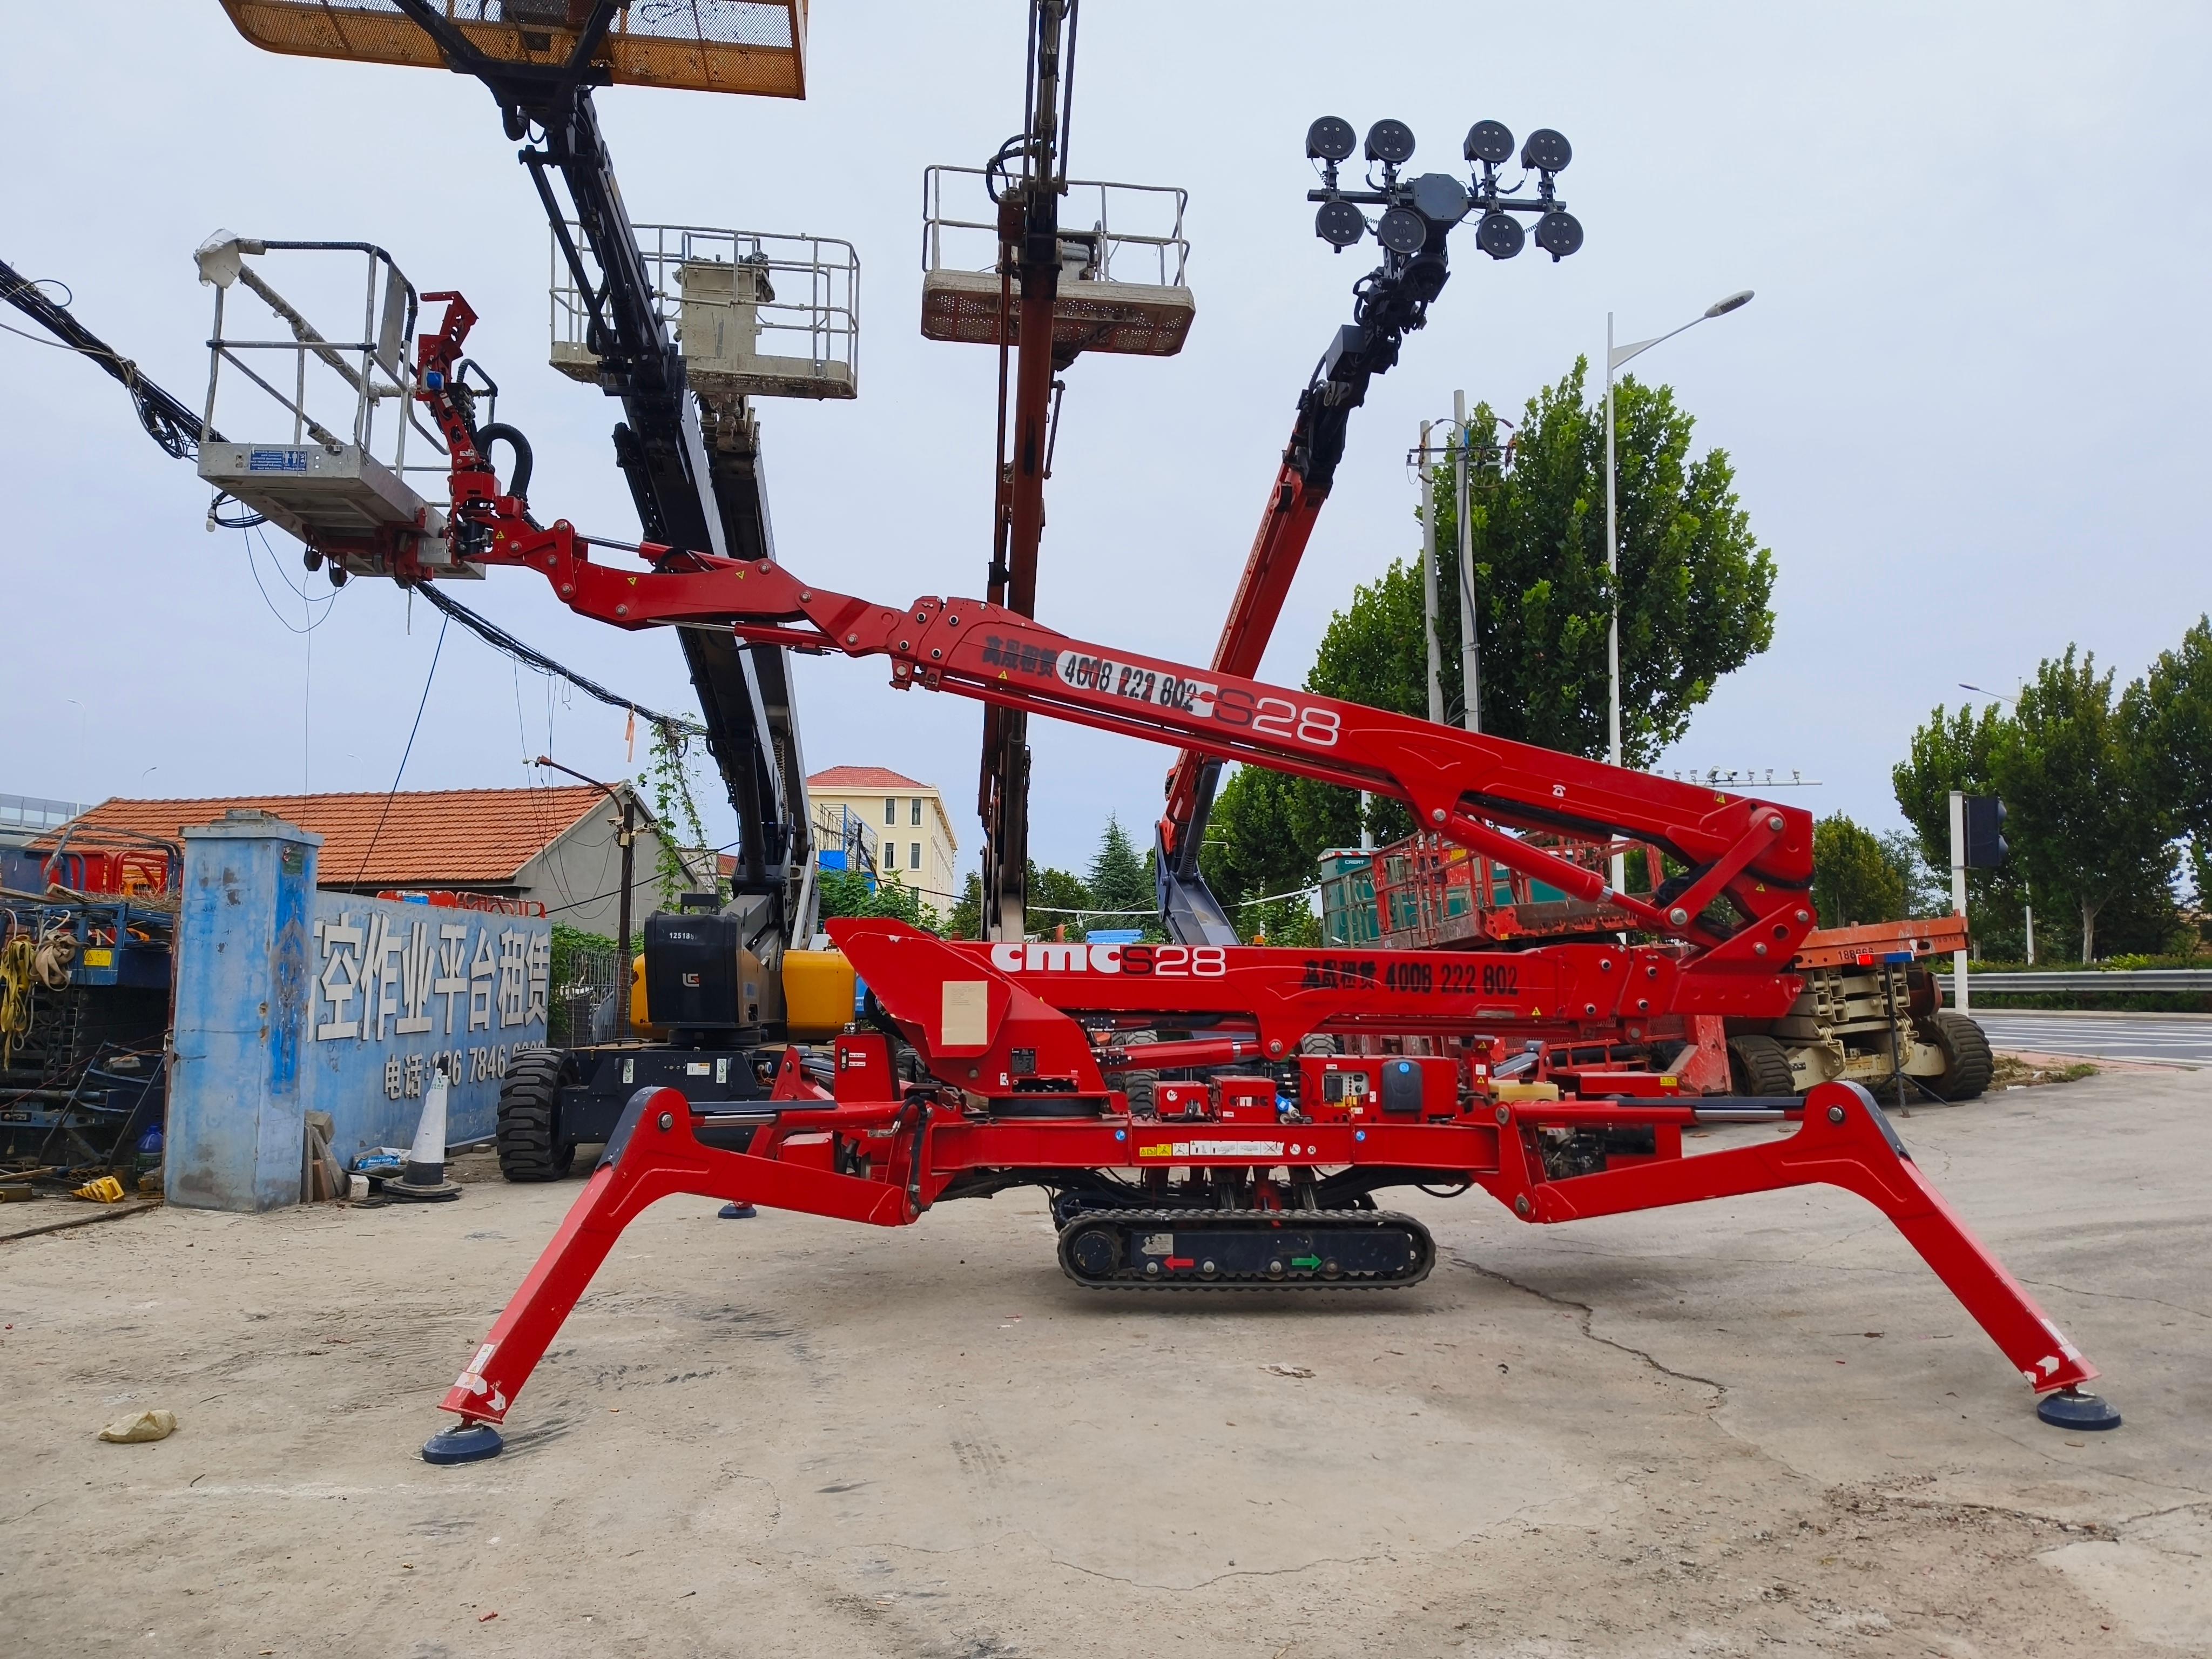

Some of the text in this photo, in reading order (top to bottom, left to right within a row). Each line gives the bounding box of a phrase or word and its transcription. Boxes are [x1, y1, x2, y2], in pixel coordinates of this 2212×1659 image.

[1065, 655, 1112, 692] 4008
[1117, 666, 1156, 700] 222
[1159, 677, 1197, 712] 802
[1215, 688, 1341, 746] S28
[1385, 961, 1432, 994] 4008
[1440, 963, 1477, 995] 222
[1482, 964, 1519, 996] 802
[469, 1044, 506, 1083] 7846
